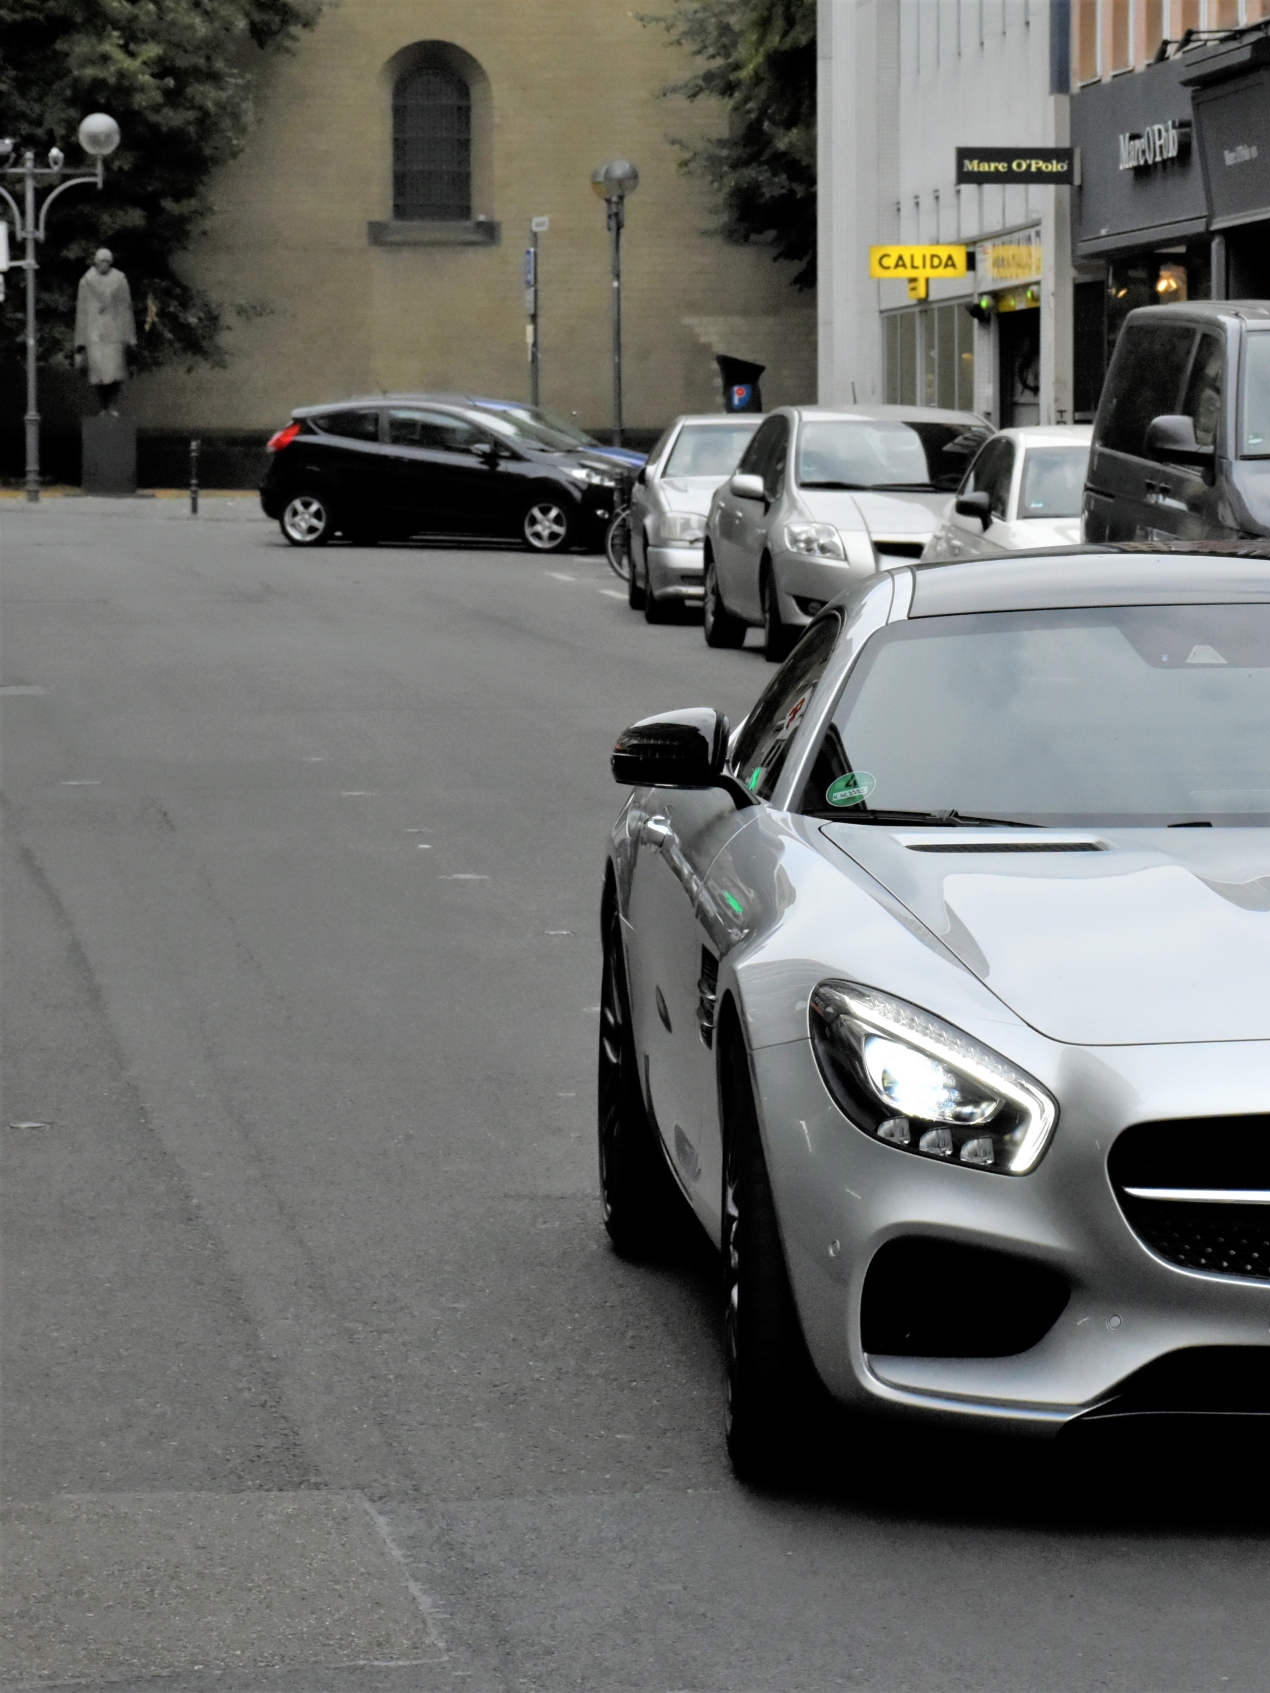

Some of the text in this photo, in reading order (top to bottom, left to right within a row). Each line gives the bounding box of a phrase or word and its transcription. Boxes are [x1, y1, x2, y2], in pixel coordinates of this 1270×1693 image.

[1119, 132, 1145, 170] Marc
[963, 159, 1068, 172] Marc O'Polo
[878, 254, 957, 270] CALIDA
